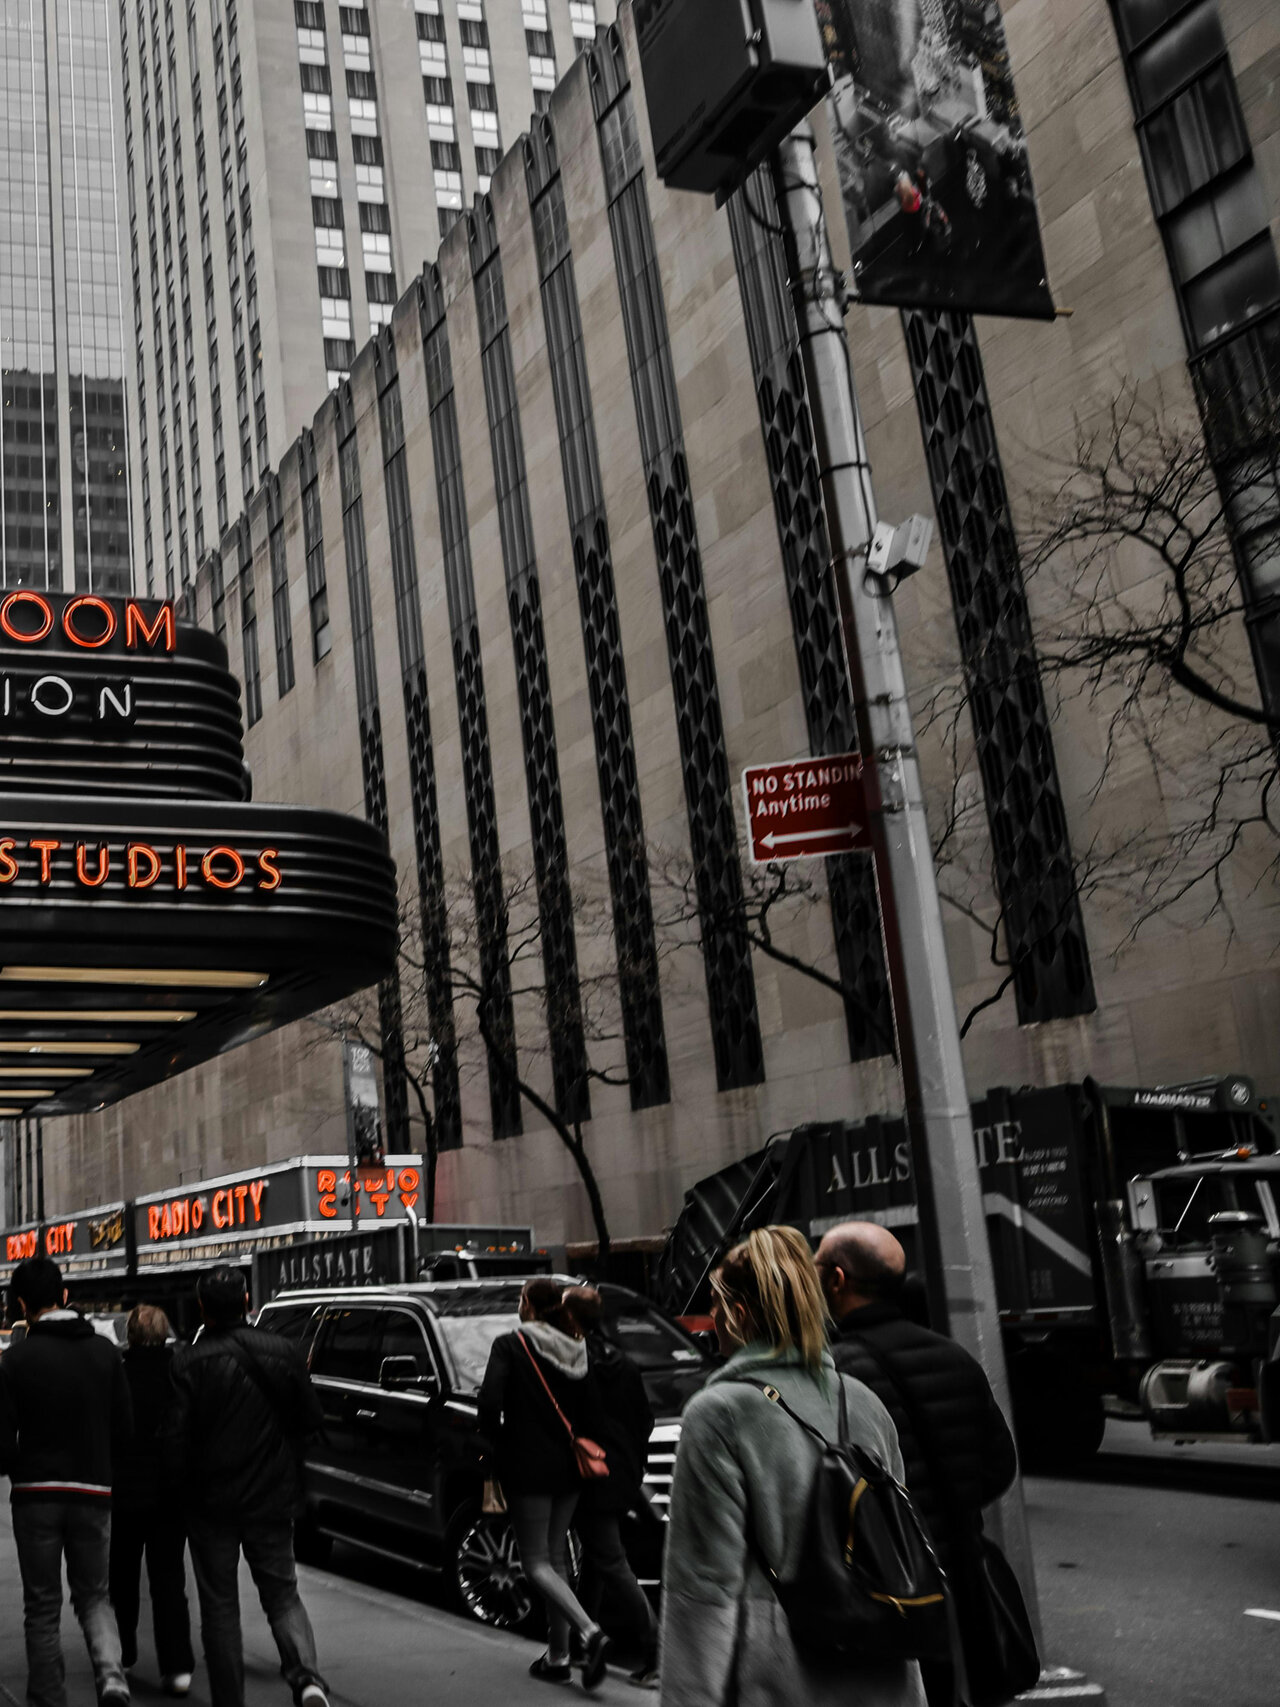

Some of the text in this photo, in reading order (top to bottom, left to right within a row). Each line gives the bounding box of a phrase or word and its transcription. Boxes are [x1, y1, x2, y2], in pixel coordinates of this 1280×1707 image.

[752, 763, 863, 797] NO STANDIN
[755, 792, 831, 819] Anytime
[826, 1120, 1025, 1194] ALLSTE
[147, 1198, 204, 1241] RADIO
[211, 1179, 265, 1229] CITY
[6, 1229, 37, 1262] RADIO
[45, 1222, 76, 1256] CITY
[278, 1246, 373, 1285] ALLSTATE
